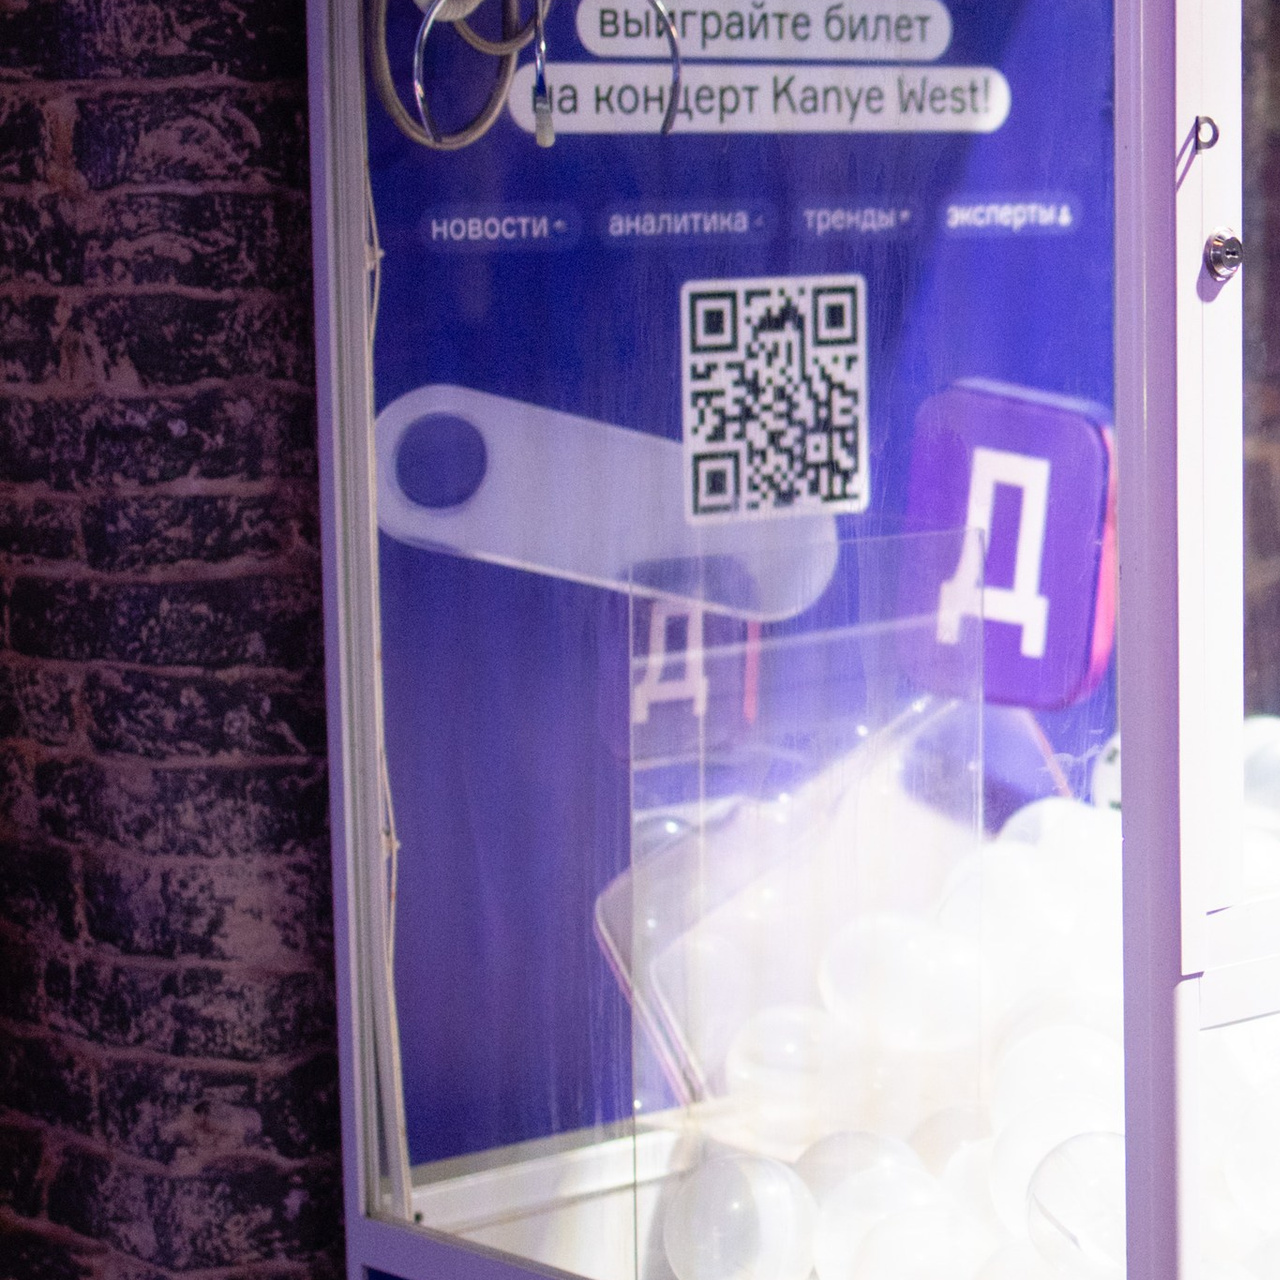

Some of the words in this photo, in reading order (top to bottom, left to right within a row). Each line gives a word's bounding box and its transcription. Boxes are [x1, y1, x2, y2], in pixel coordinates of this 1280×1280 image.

[599, 3, 810, 50] выиграйте
[824, 3, 932, 43] билет
[772, 75, 884, 123] Kanye
[897, 75, 991, 114] West!
[431, 217, 549, 241] новости
[608, 210, 749, 237] аналитика
[803, 207, 896, 236] тренды
[936, 446, 1051, 658] Д
